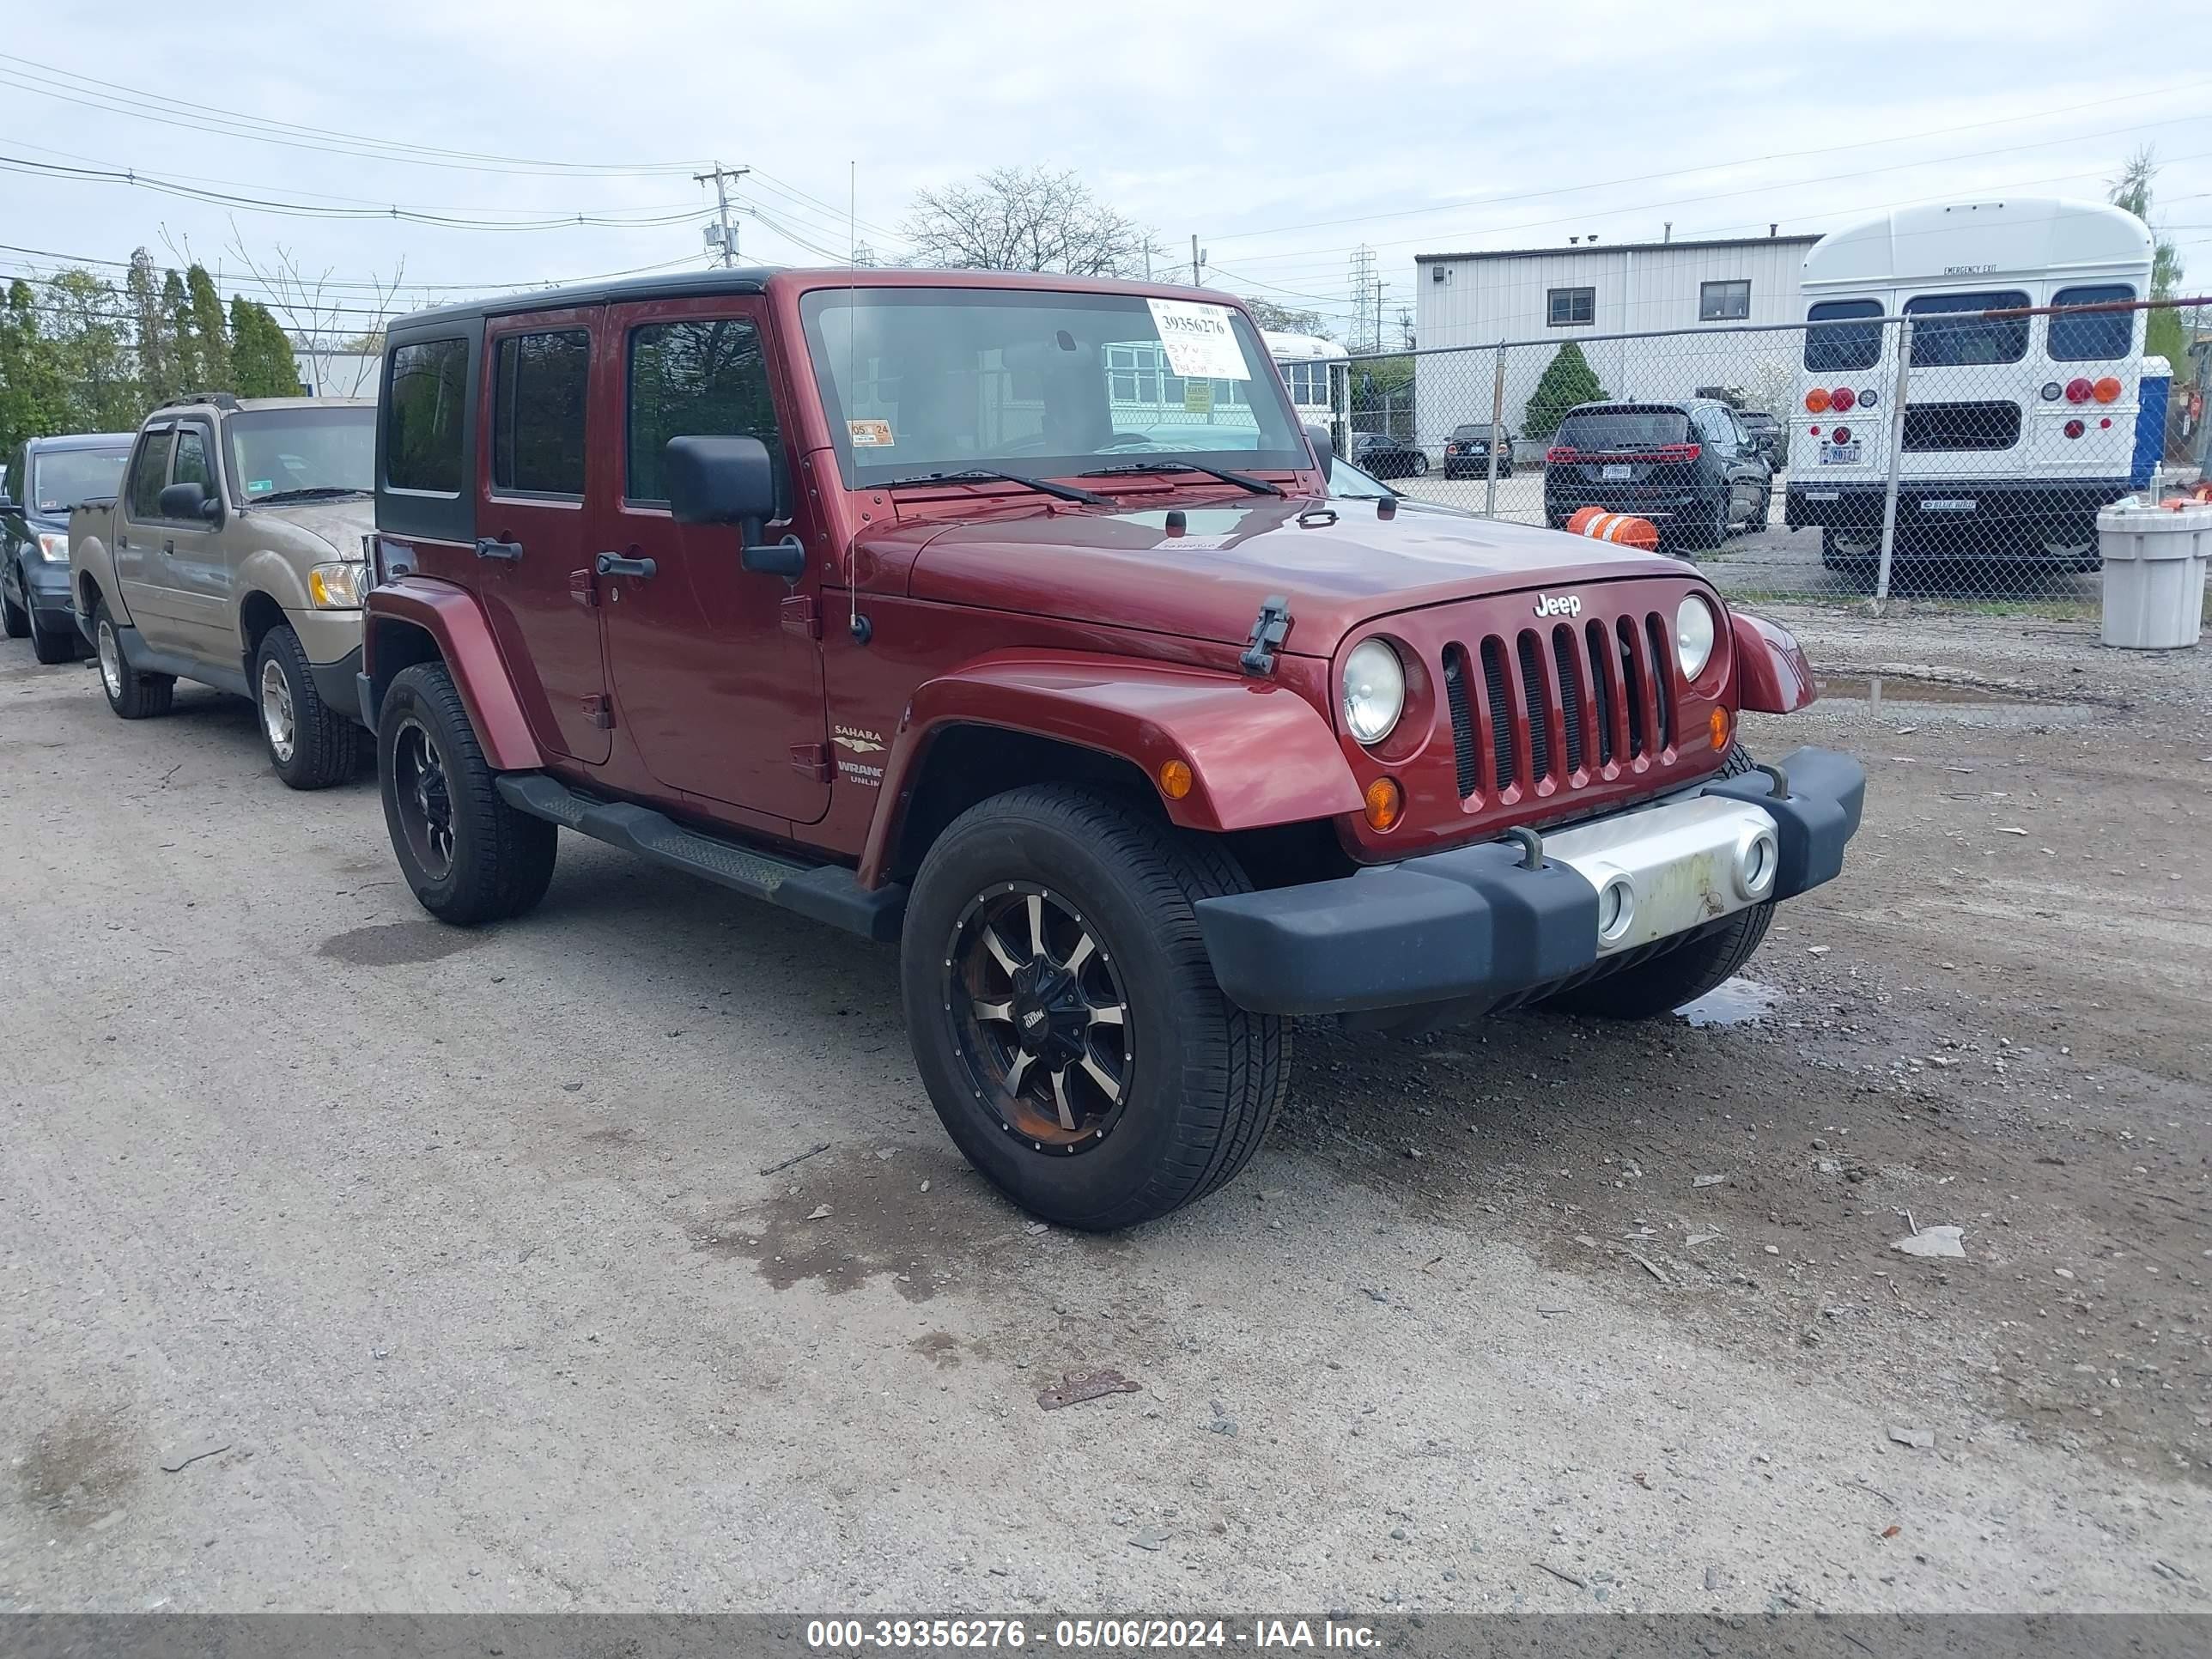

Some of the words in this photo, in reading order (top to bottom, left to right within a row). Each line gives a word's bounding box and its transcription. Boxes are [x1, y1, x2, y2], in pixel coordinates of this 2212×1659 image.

[1943, 264, 1980, 276] EMERGENCY
[1983, 264, 1997, 274] EXIT
[1162, 315, 1224, 335] 39356276
[853, 425, 866, 434] 05
[876, 425, 889, 434] 24
[1533, 593, 1582, 618] Jeep
[835, 725, 883, 741] SAHARA
